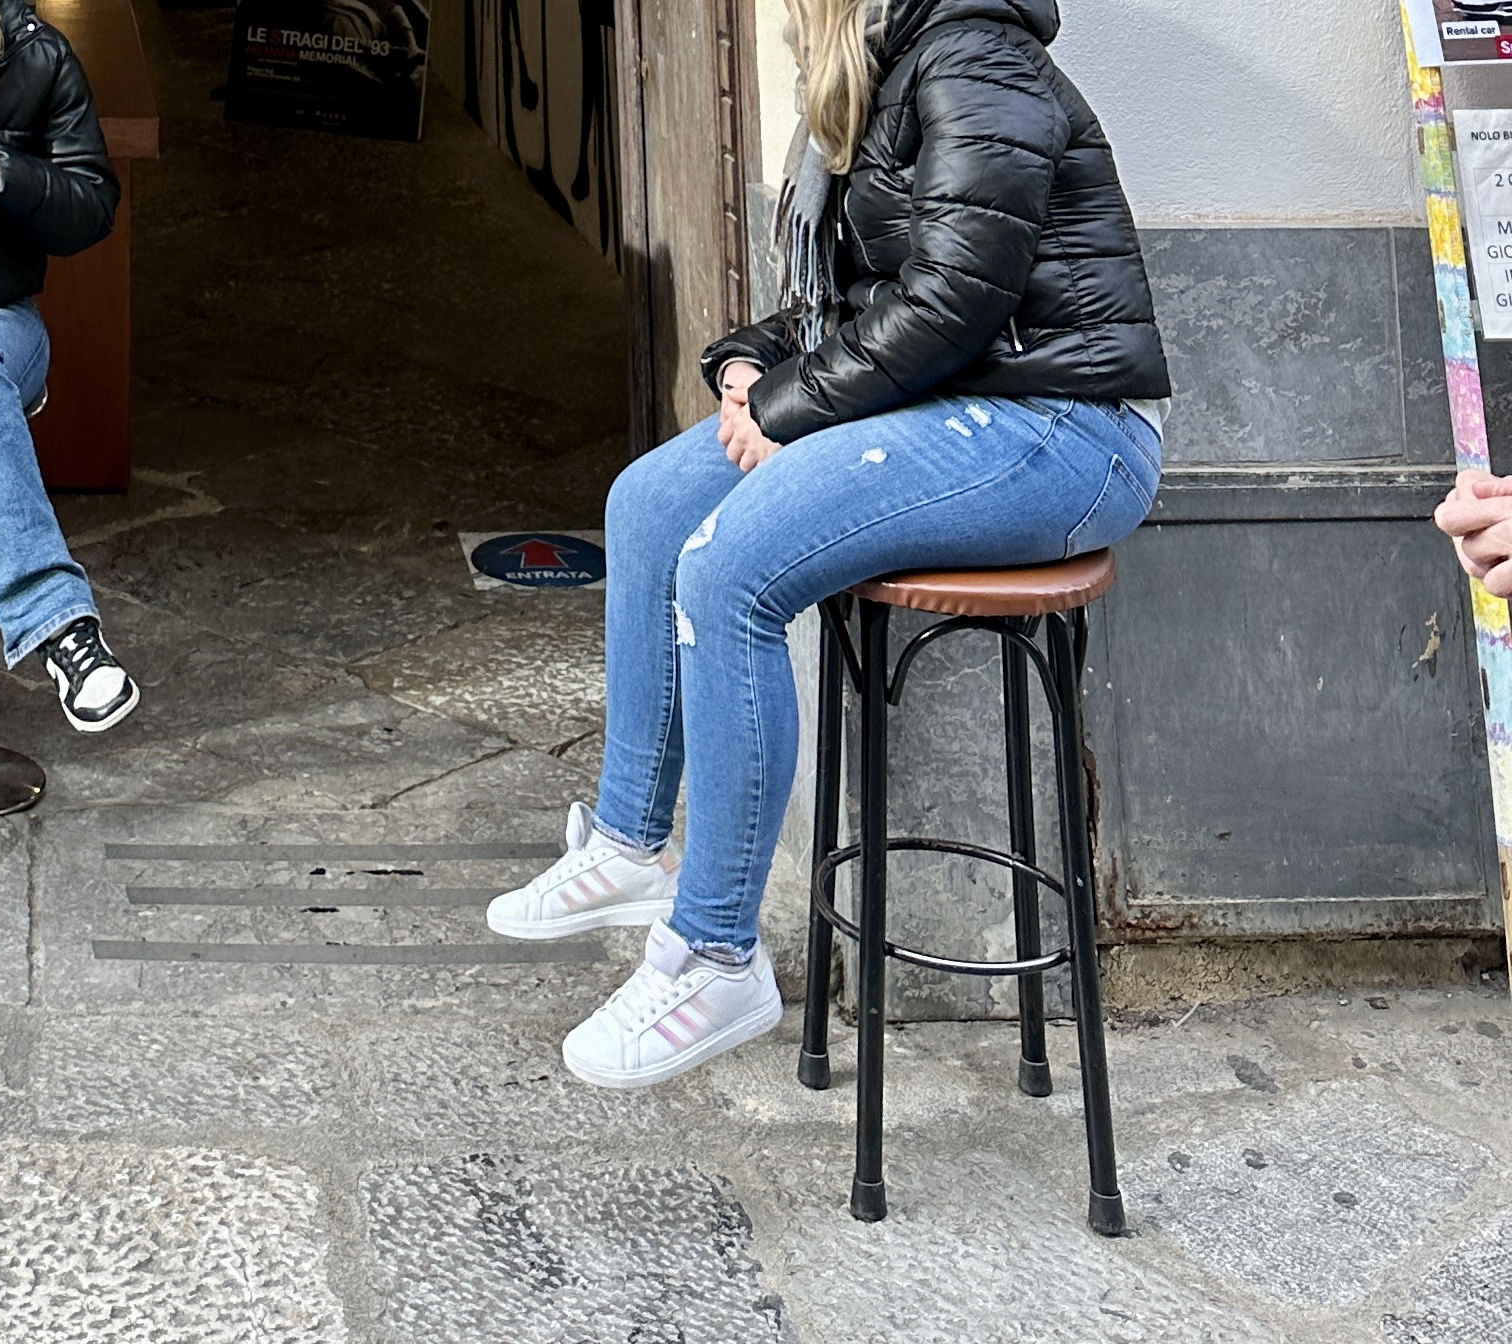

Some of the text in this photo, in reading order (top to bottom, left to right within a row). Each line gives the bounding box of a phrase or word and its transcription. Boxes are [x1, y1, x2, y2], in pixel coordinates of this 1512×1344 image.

[1446, 26, 1497, 36] Rental car
[247, 25, 389, 57] LE STRAGI DEL '93
[299, 50, 358, 65] MEMORIAL
[1471, 131, 1501, 141] NOLO
[1494, 173, 1505, 187] 2
[505, 570, 593, 580] ENTRATA
